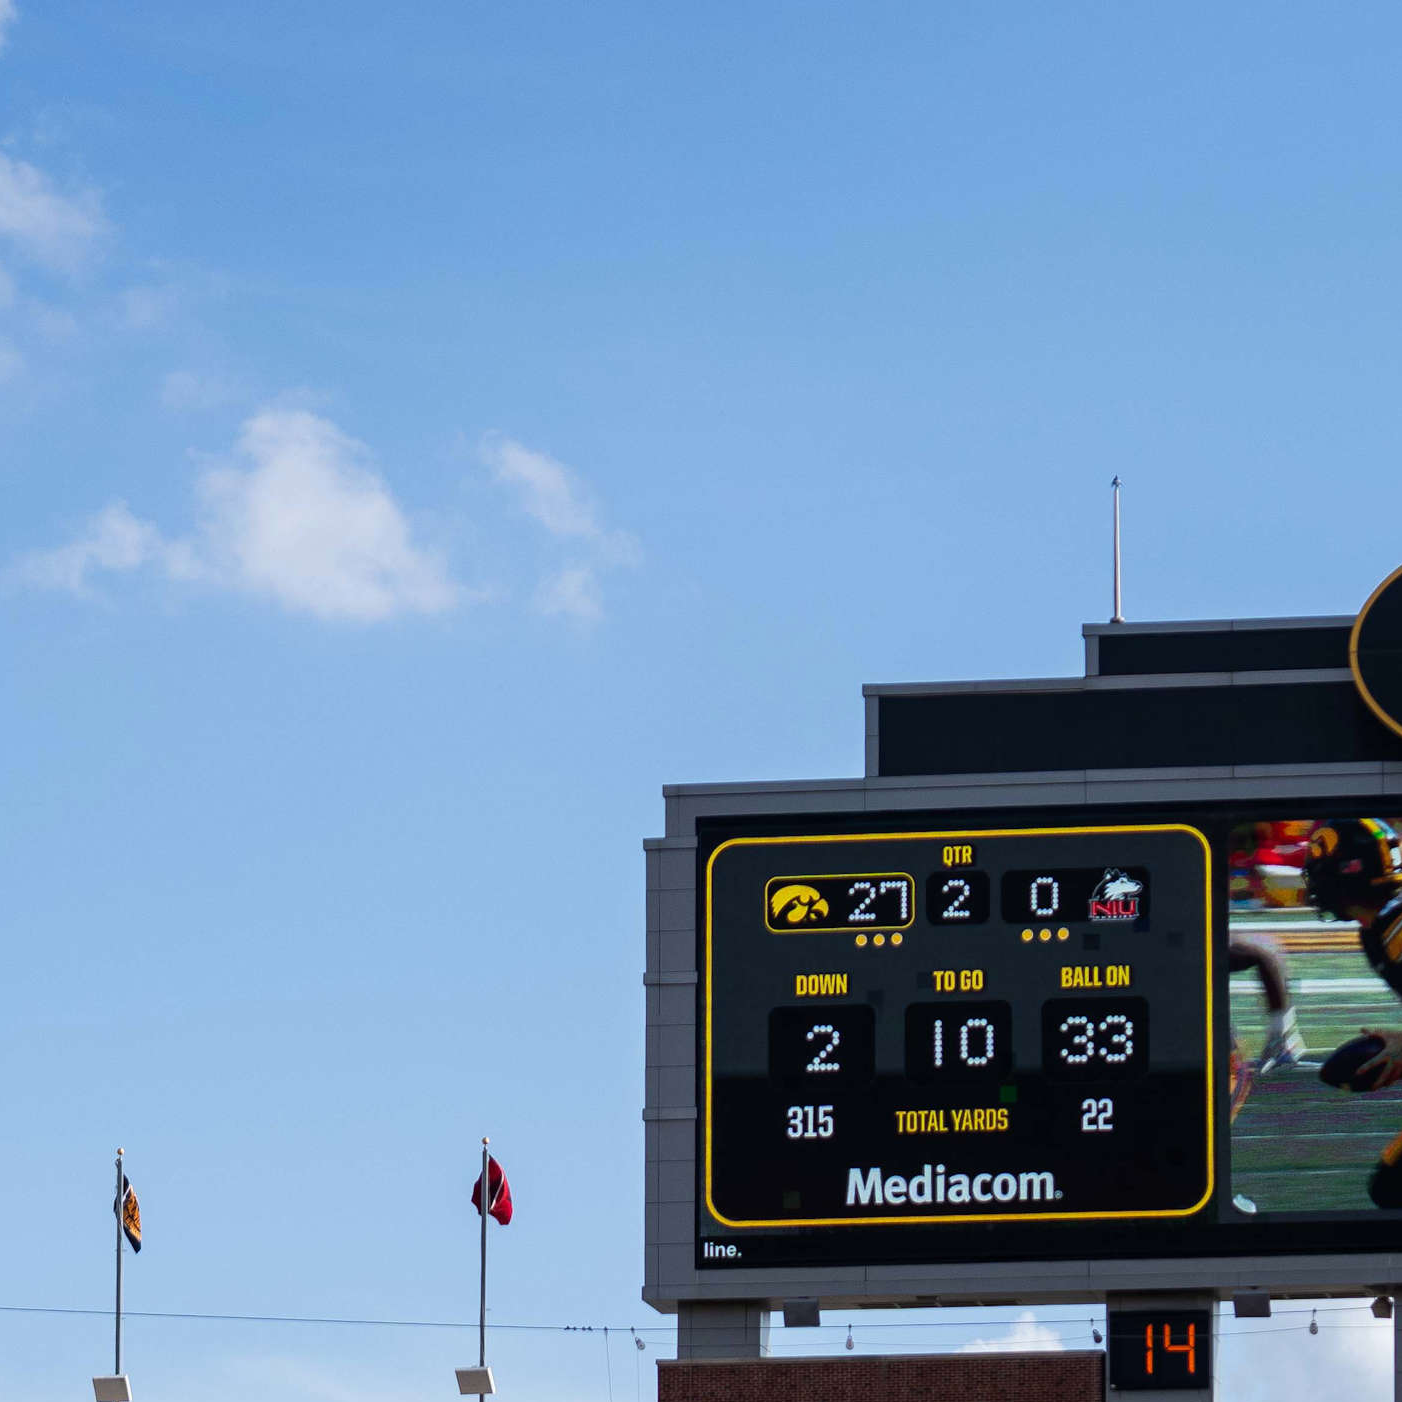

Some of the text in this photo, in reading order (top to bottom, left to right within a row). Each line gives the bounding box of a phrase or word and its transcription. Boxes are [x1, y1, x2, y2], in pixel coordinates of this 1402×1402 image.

[943, 846, 973, 866] QTR
[848, 880, 908, 922] 27
[942, 879, 971, 919] 2
[1030, 876, 1059, 917] 0
[1090, 899, 1138, 917] NIU
[795, 974, 848, 996] DOWN
[933, 969, 984, 992] TO GO
[1060, 965, 1131, 988] BALL ON
[805, 1024, 841, 1072] 2
[933, 1017, 995, 1067] 10
[1060, 1013, 1134, 1063] 33
[787, 1104, 835, 1139] 315
[895, 1108, 1009, 1133] TOTAL YARDS
[1081, 1098, 1114, 1131] 22
[846, 1164, 1055, 1206] Mediacom
[703, 1241, 742, 1259] line.
[1145, 1322, 1197, 1375] 14
